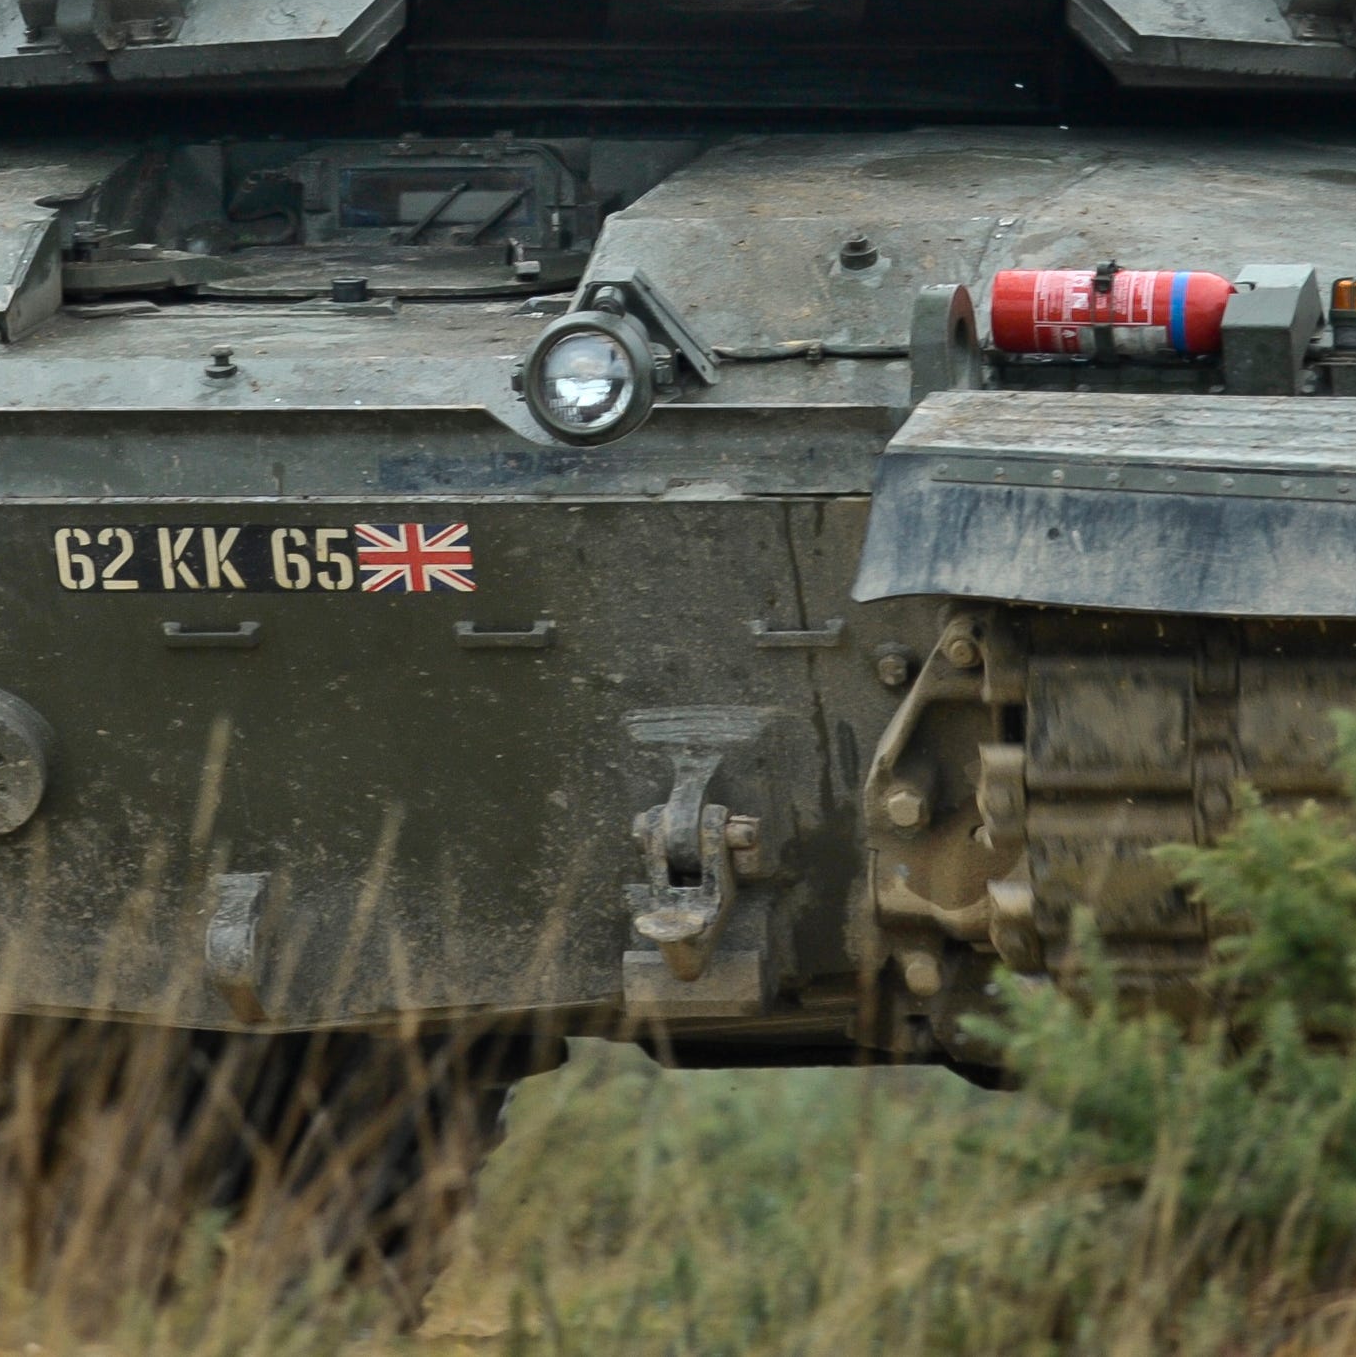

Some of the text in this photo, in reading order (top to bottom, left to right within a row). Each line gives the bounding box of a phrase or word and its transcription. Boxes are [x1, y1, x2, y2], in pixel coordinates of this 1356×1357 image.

[54, 527, 353, 590] 62 KK 65
